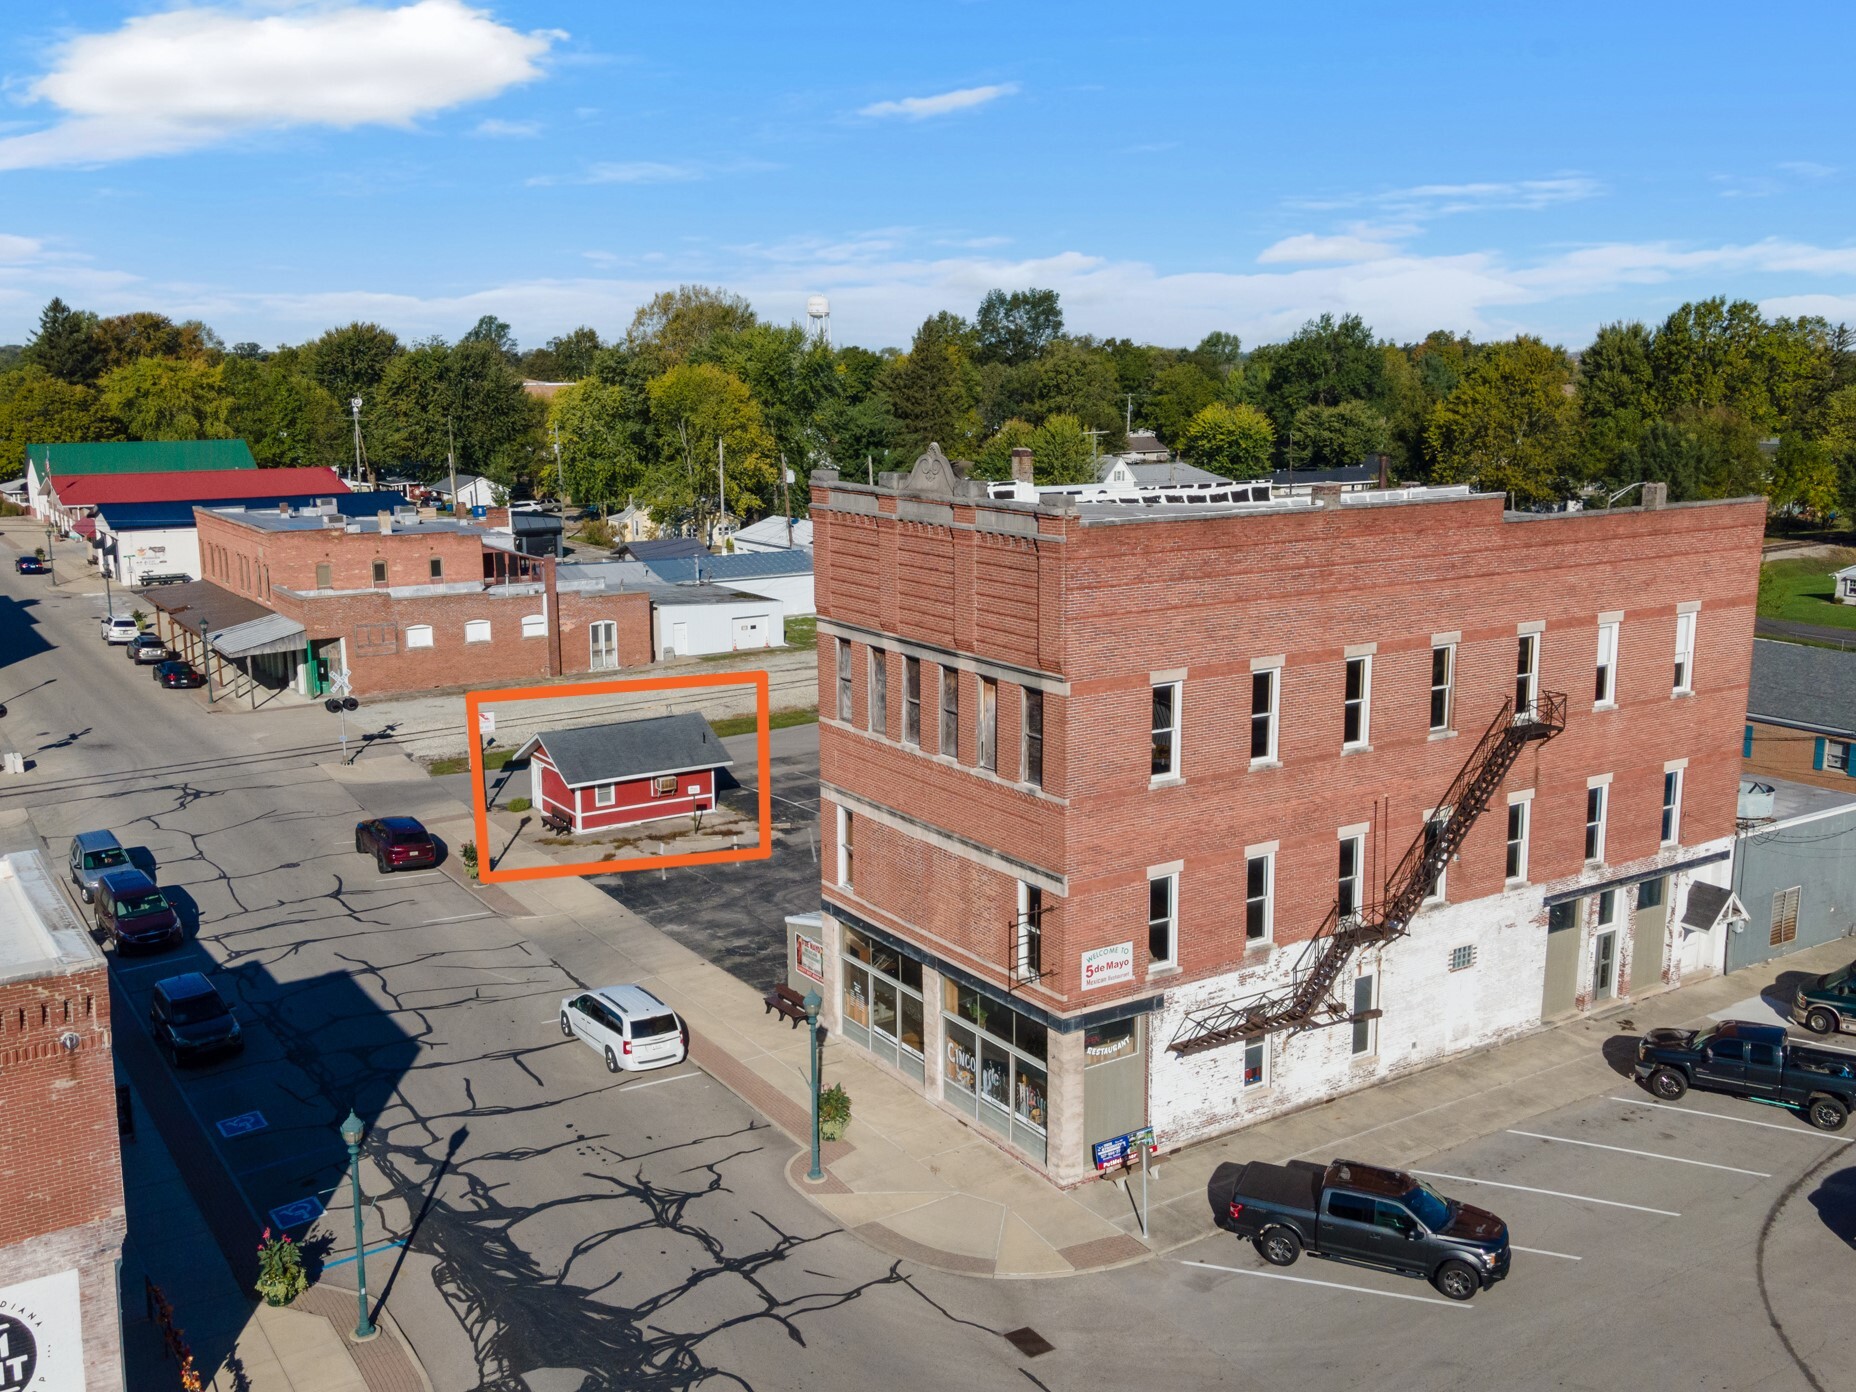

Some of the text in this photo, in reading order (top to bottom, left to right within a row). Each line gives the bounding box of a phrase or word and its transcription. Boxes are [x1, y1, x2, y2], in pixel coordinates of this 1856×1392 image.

[1086, 946, 1129, 963] WELCOME TO
[1106, 959, 1130, 971] Mayo
[1086, 977, 1107, 986] Mexican
[1086, 1034, 1130, 1056] RESTAURANT
[947, 1042, 976, 1073] CINCO
